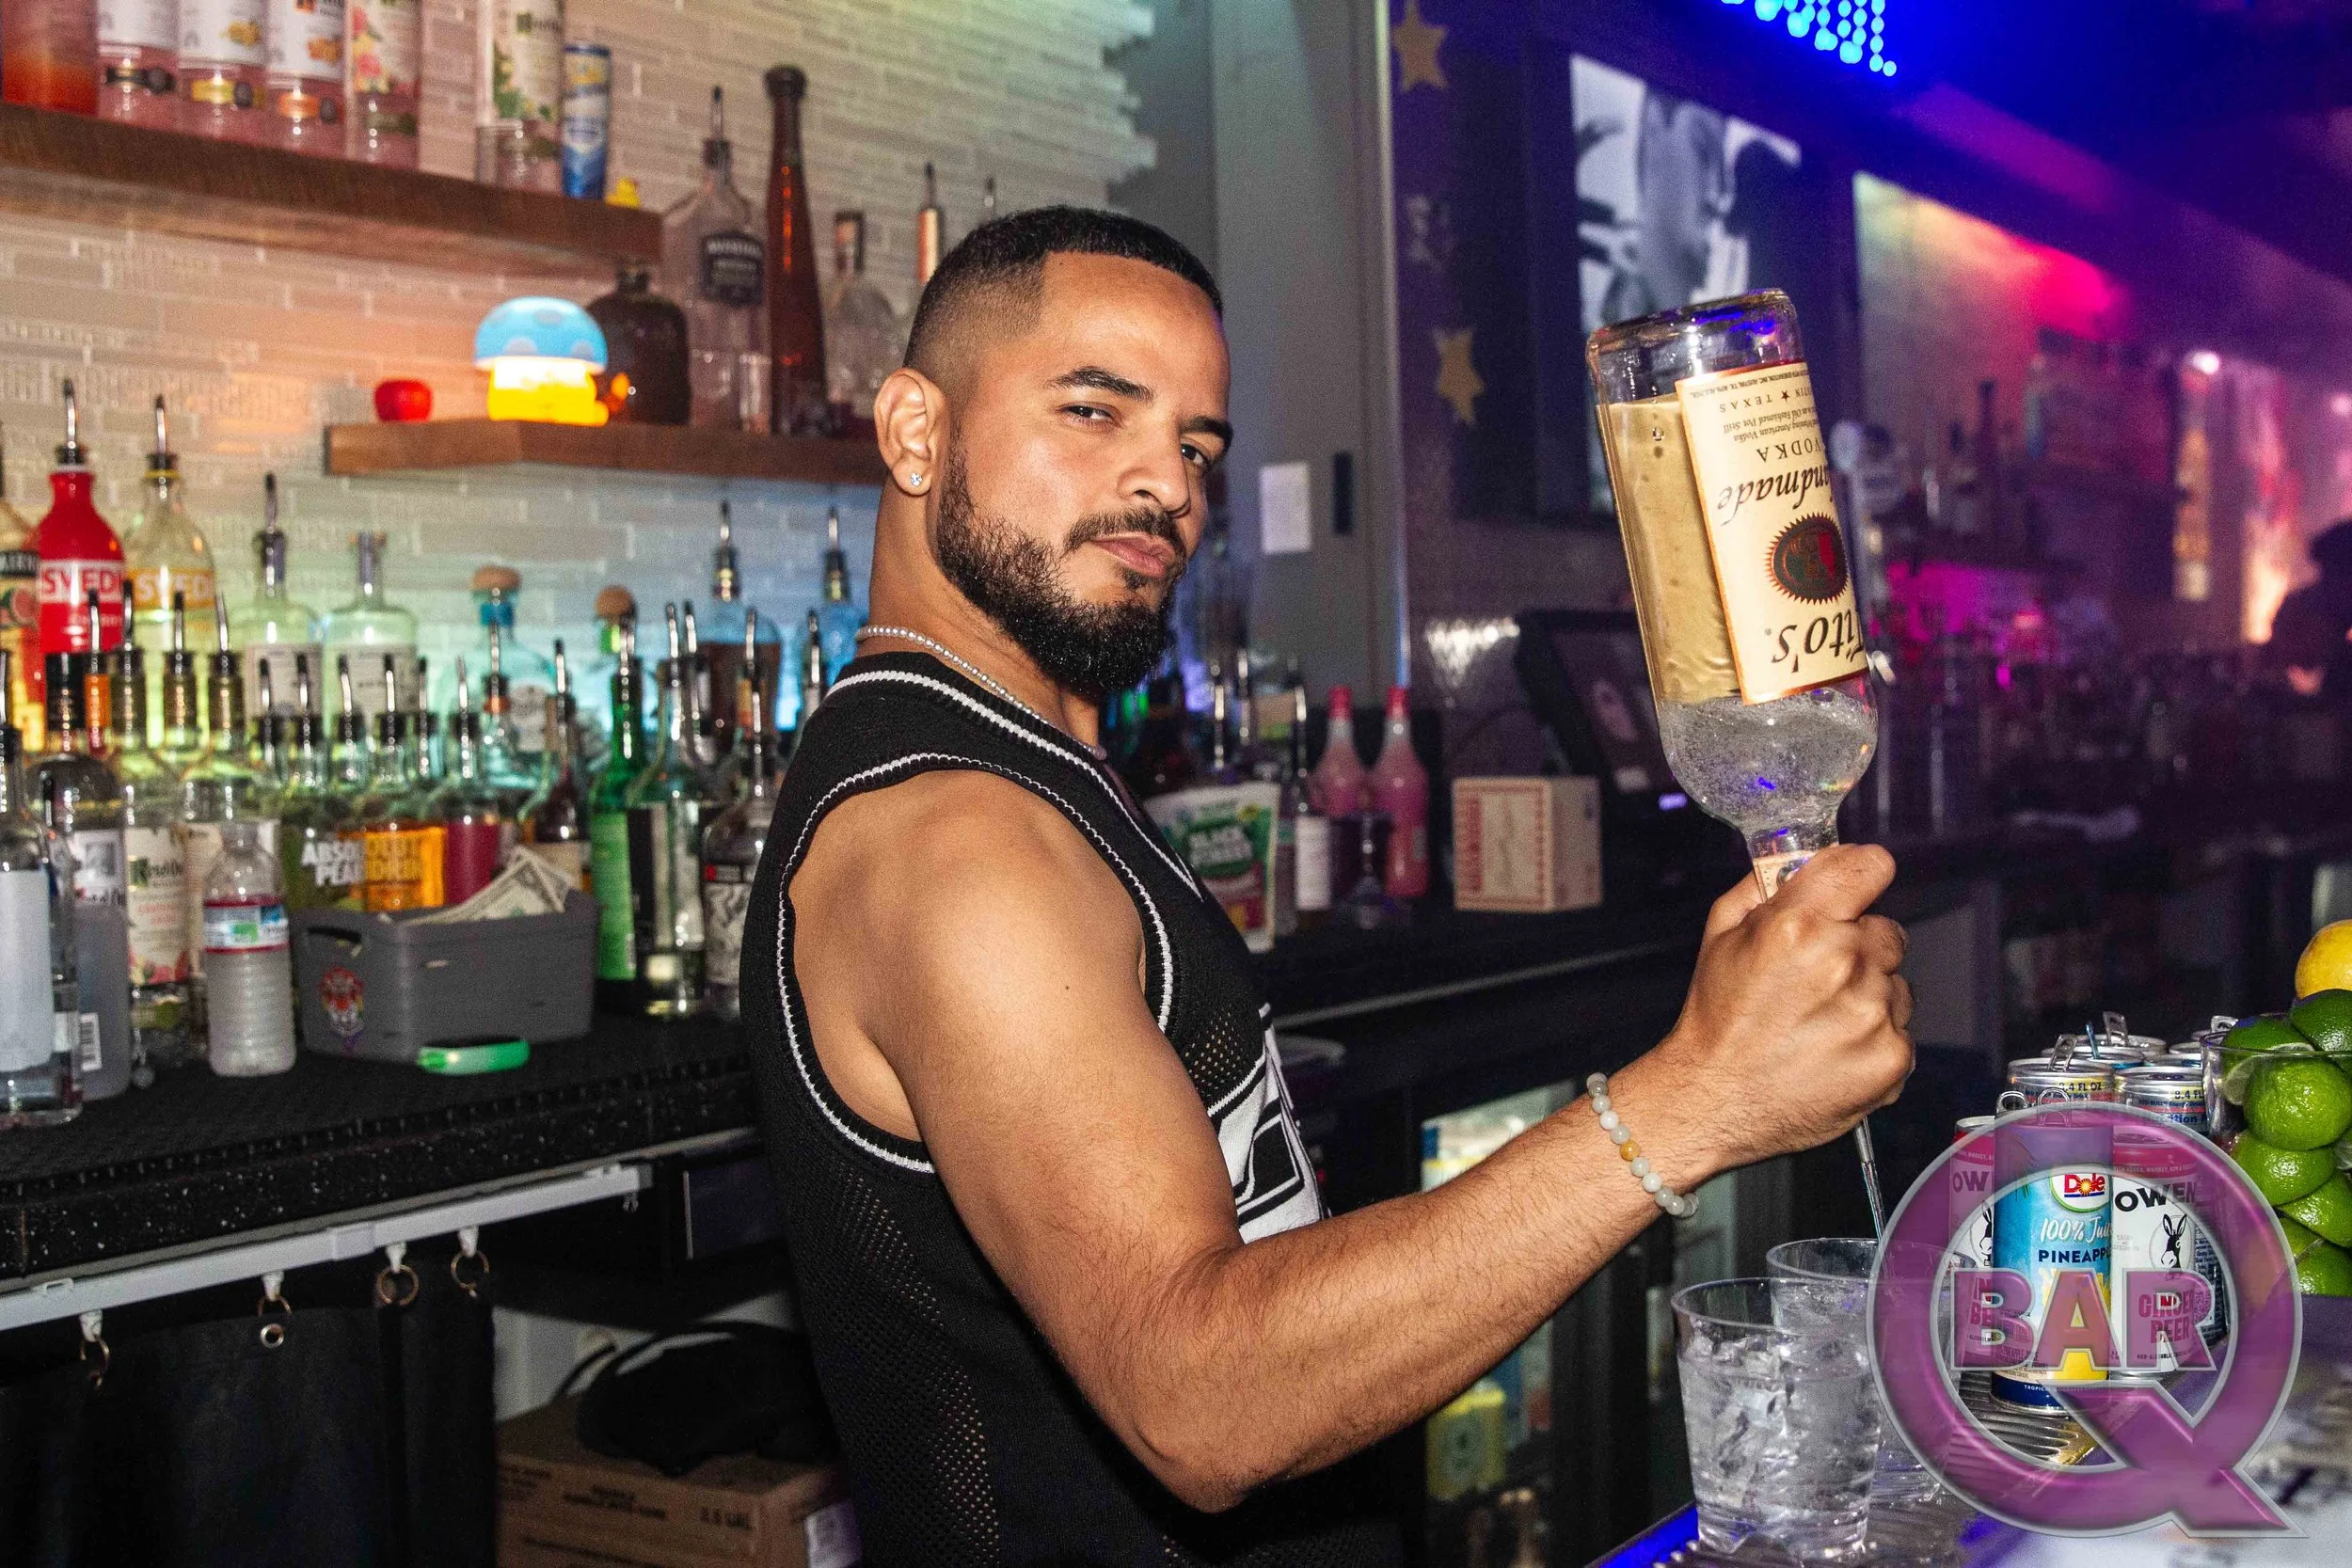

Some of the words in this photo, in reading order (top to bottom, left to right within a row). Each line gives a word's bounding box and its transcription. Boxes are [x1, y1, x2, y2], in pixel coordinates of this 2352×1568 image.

[1720, 394, 1773, 414] TEXAS
[1743, 419, 1757, 429] Pot
[1758, 412, 1791, 427] Fashioned
[1724, 421, 1740, 434] Still
[1758, 423, 1792, 436] American
[1733, 430, 1758, 444] Vodka
[1756, 436, 1822, 463] VODKA
[2078, 1083, 2088, 1091] FL
[2090, 1081, 2103, 1091] OZ
[2174, 1090, 2191, 1100] 8.4
[2063, 1173, 2106, 1195] Dole
[2040, 1216, 2084, 1243] 100%
[2138, 1289, 2195, 1318] GINGER
[2150, 1316, 2190, 1344] BEER
